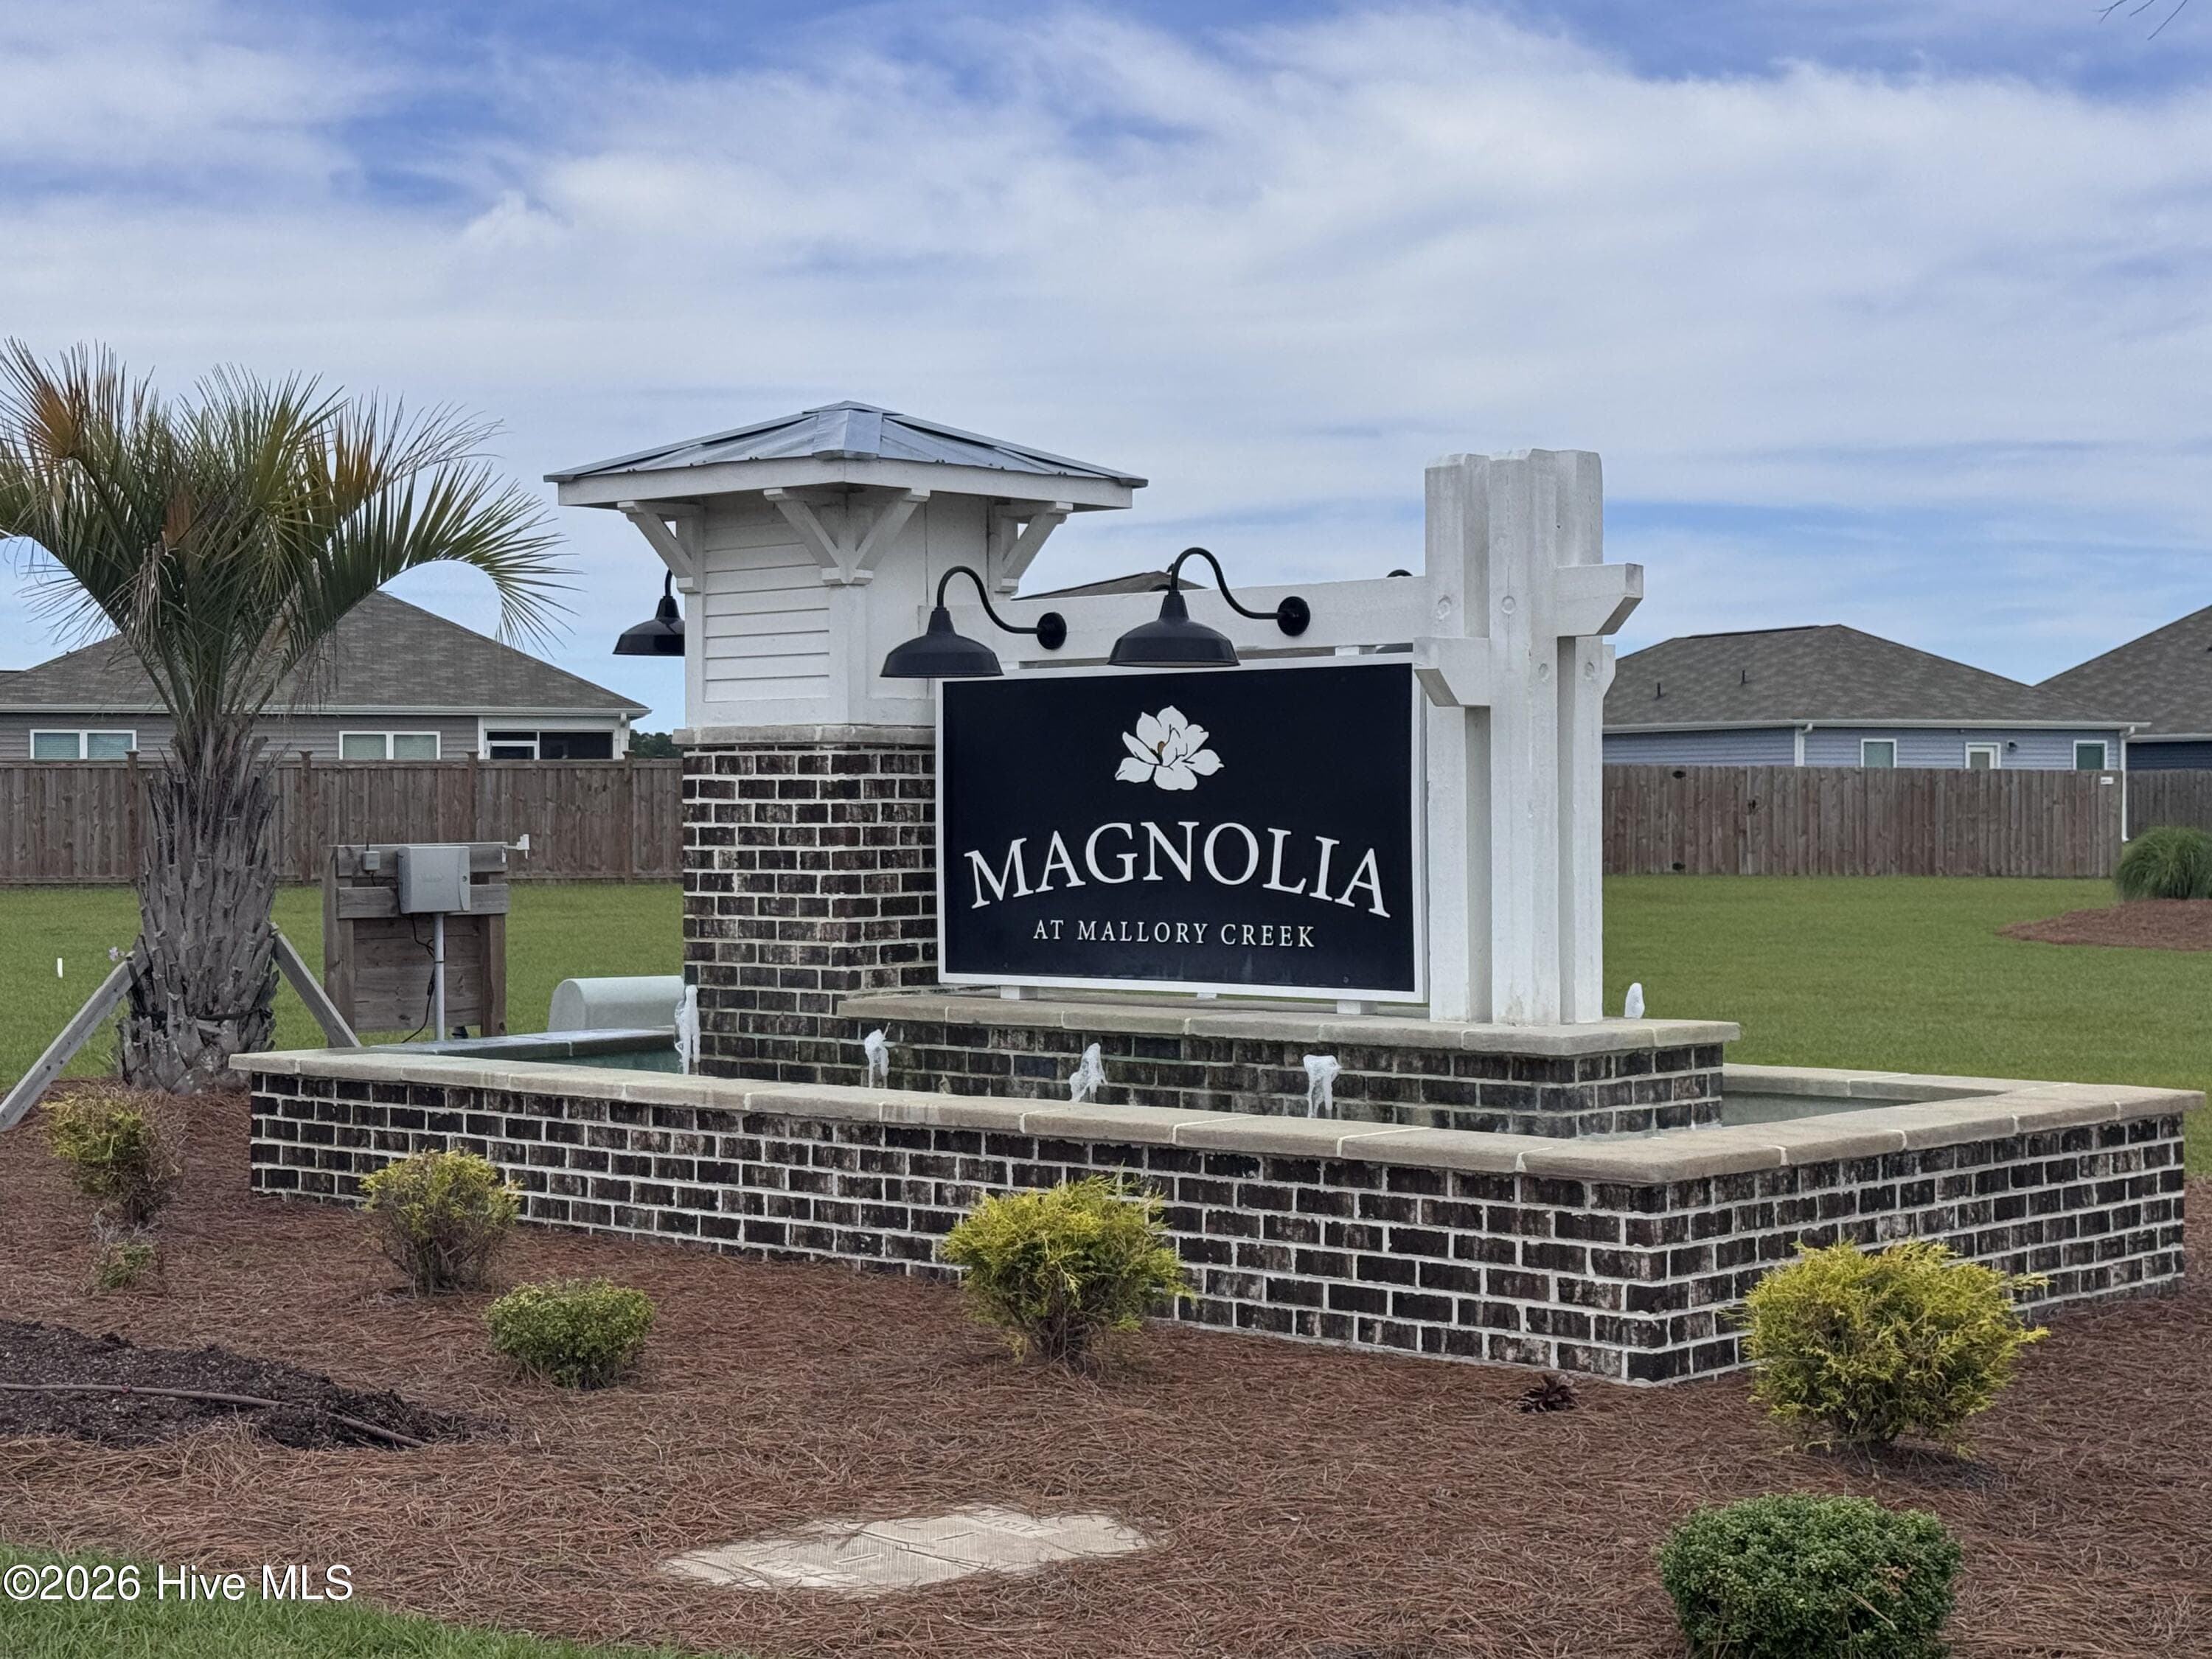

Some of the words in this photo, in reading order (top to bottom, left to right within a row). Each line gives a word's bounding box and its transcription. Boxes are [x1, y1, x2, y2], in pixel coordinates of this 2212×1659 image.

[964, 821, 1391, 918] MAGNOLIA
[1033, 919, 1065, 941] AT
[1077, 920, 1208, 945] MALLORY
[1220, 924, 1315, 948] CREEK
